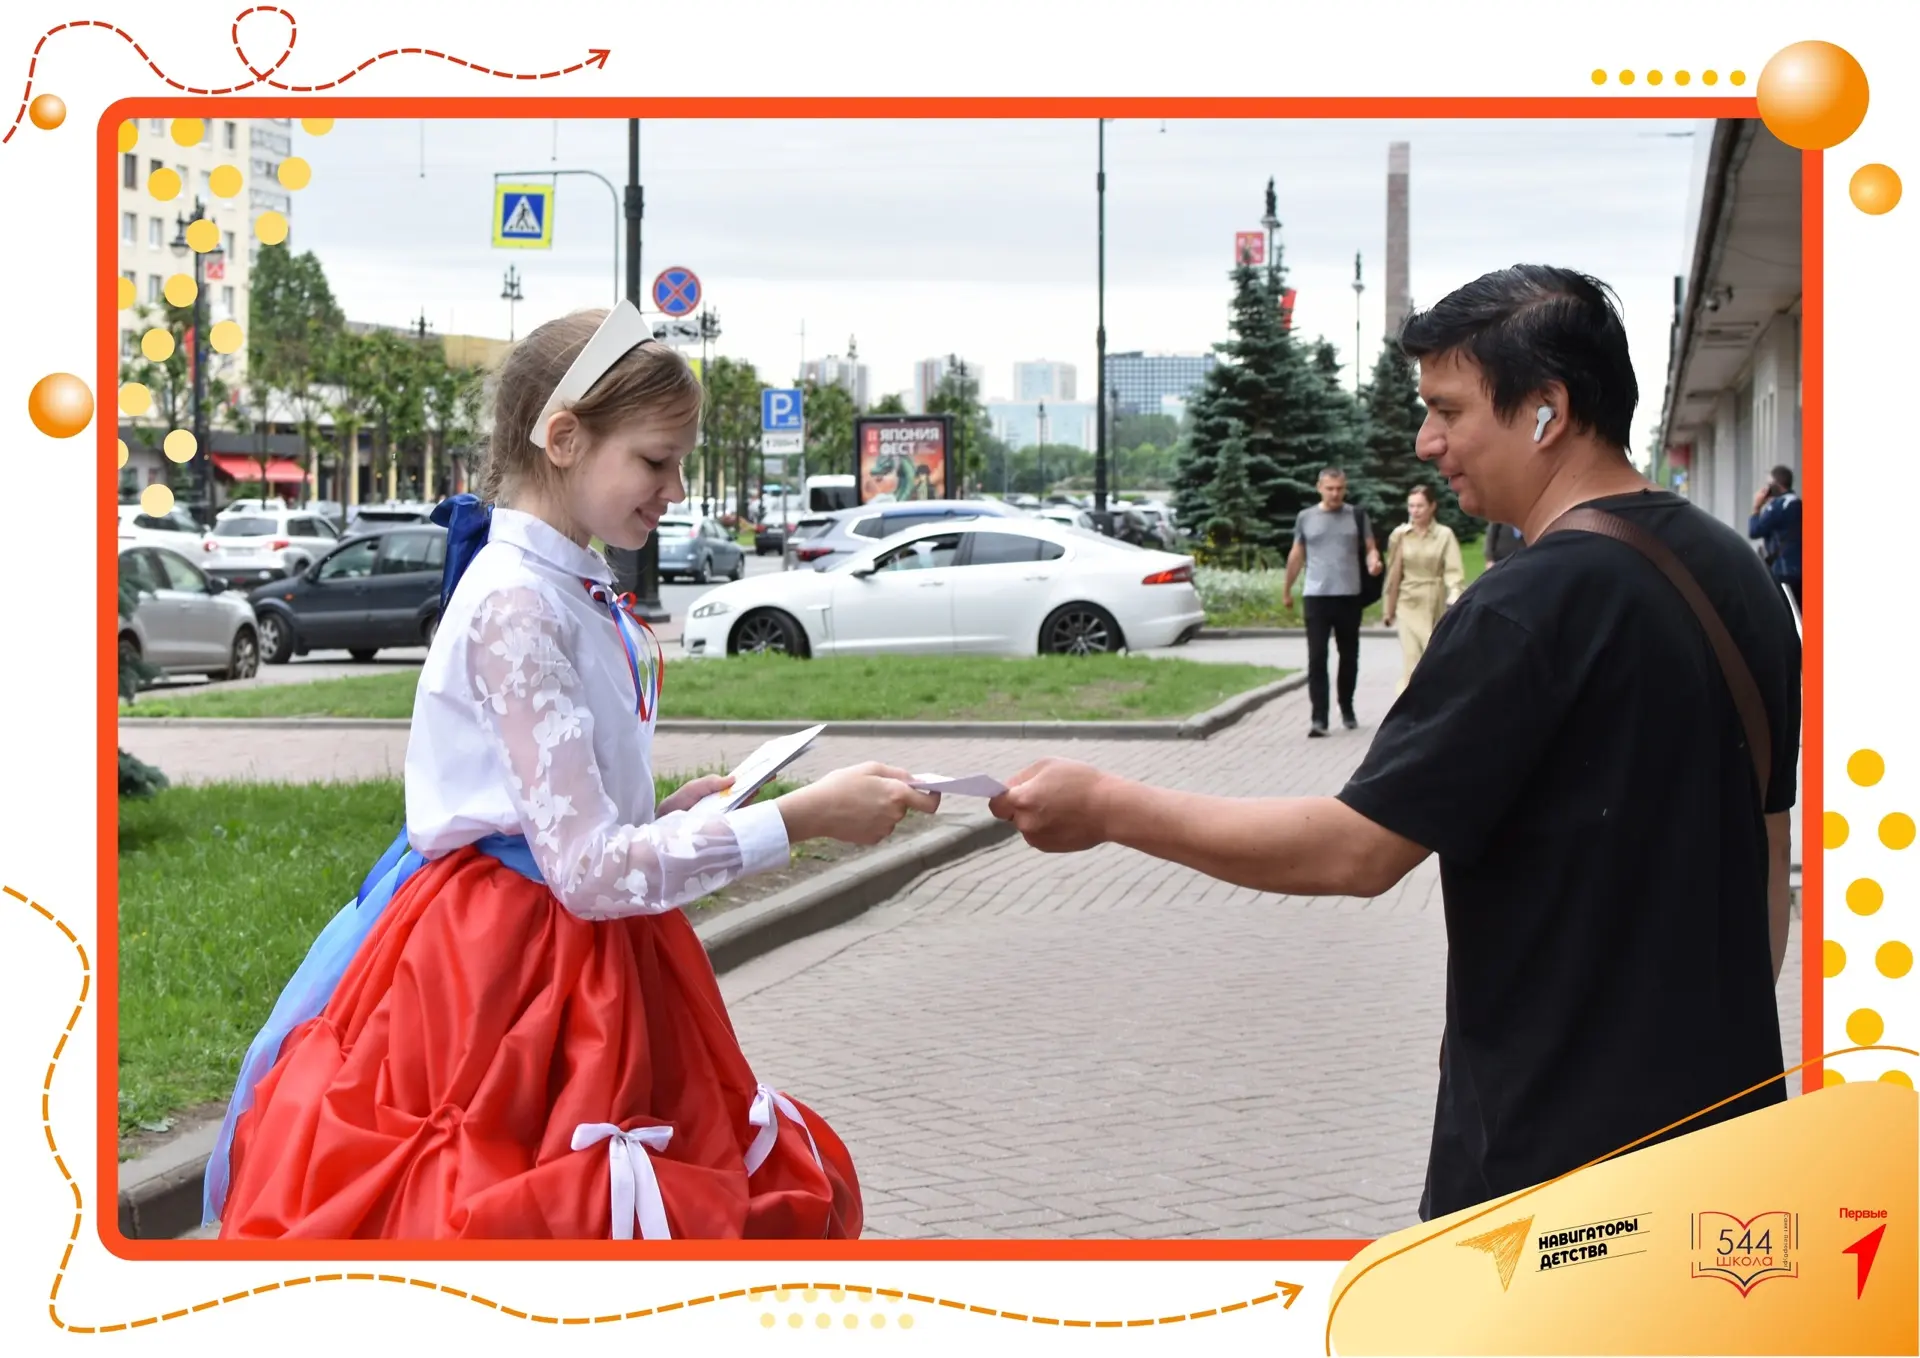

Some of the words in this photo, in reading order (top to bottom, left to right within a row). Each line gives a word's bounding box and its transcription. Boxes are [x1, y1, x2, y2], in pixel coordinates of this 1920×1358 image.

[770, 394, 792, 426] P
[880, 428, 939, 442] ЯПОНИЯ
[880, 443, 915, 455] ФЕСТ
